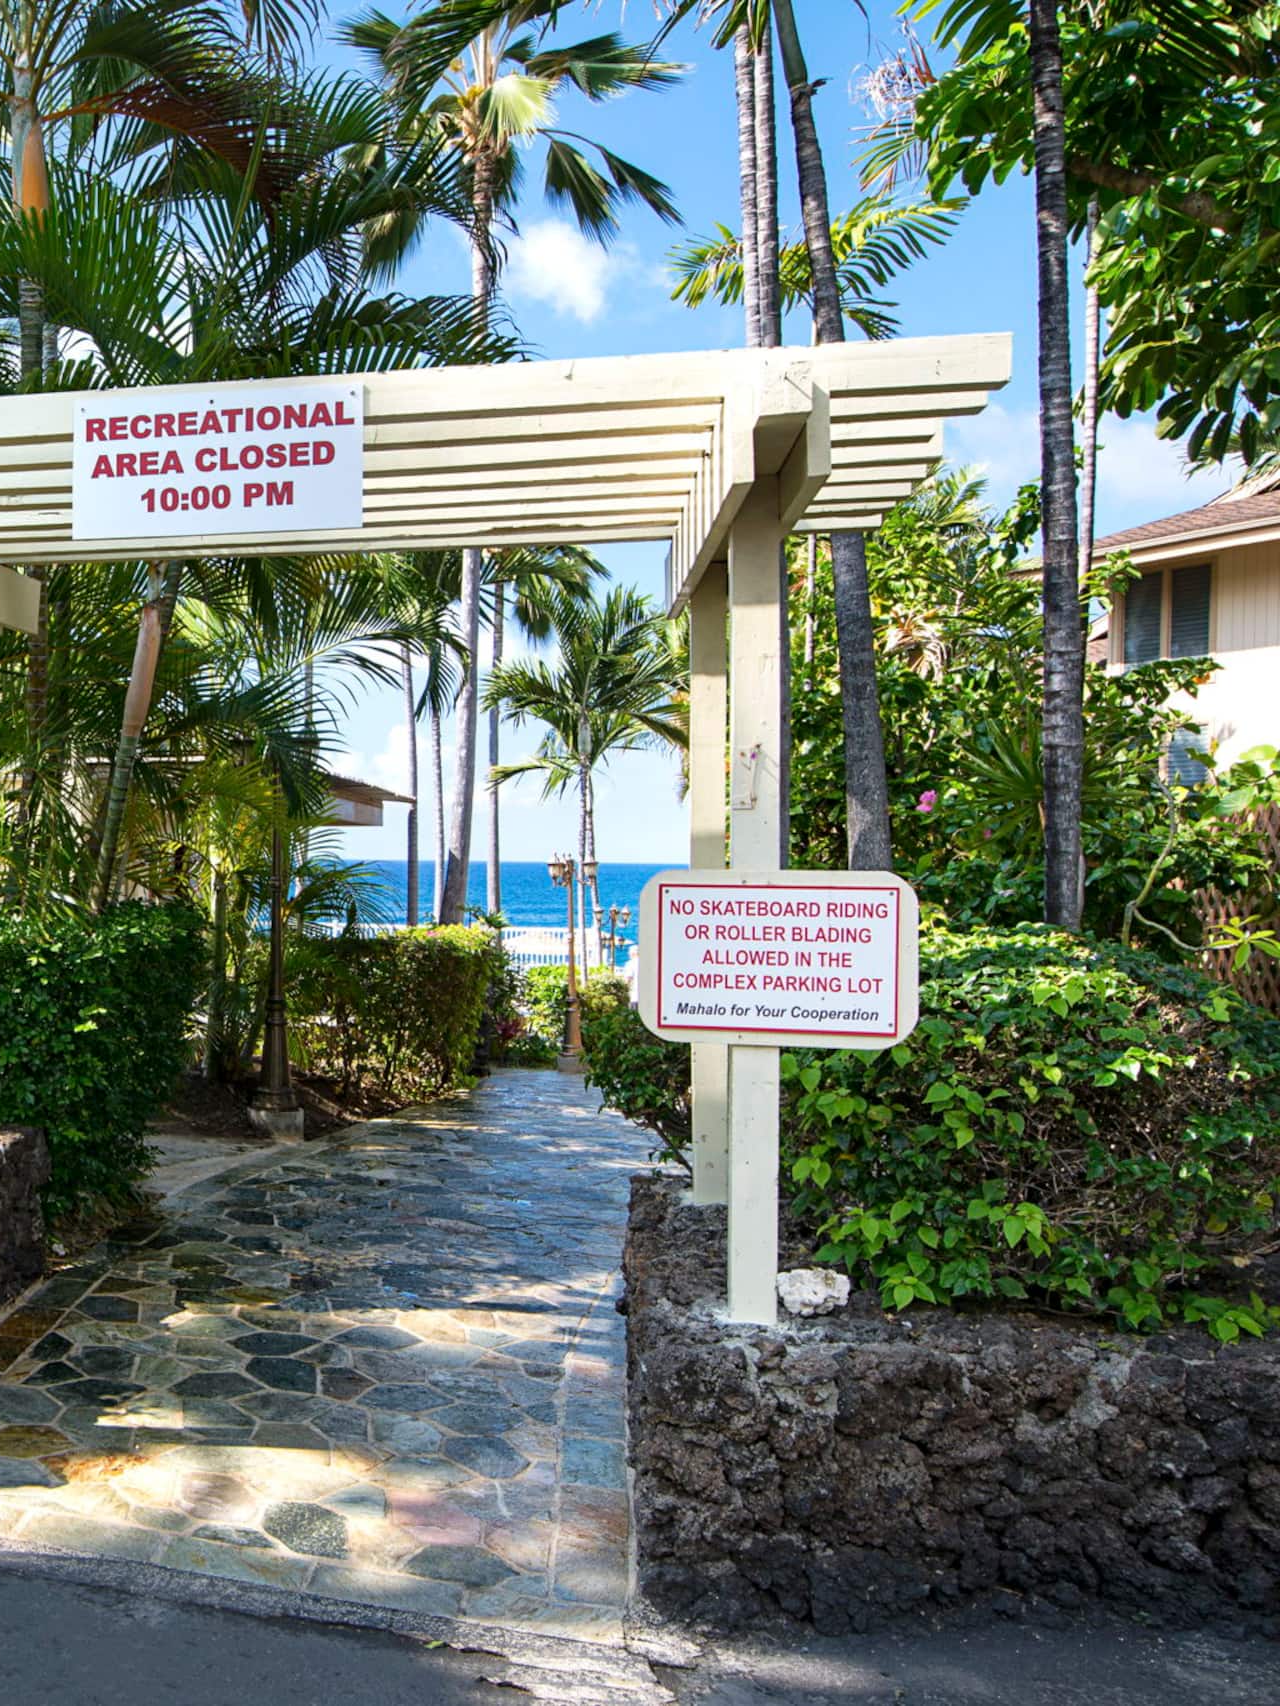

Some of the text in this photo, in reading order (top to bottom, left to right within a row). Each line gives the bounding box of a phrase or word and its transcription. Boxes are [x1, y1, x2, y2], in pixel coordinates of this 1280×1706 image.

[86, 402, 354, 442] RECREATIONAL
[91, 441, 335, 478] AREA CLOSED
[141, 482, 294, 512] 10:00 PM
[670, 900, 888, 918] NO SKATEBOARD RIDING
[685, 925, 871, 943] OR ROLLER BLADING
[702, 950, 852, 968] ALLOWED IN THE
[673, 973, 883, 994] COMPLEX PARKING LOT
[676, 1002, 878, 1022] Mahalo for Your Cooperation
